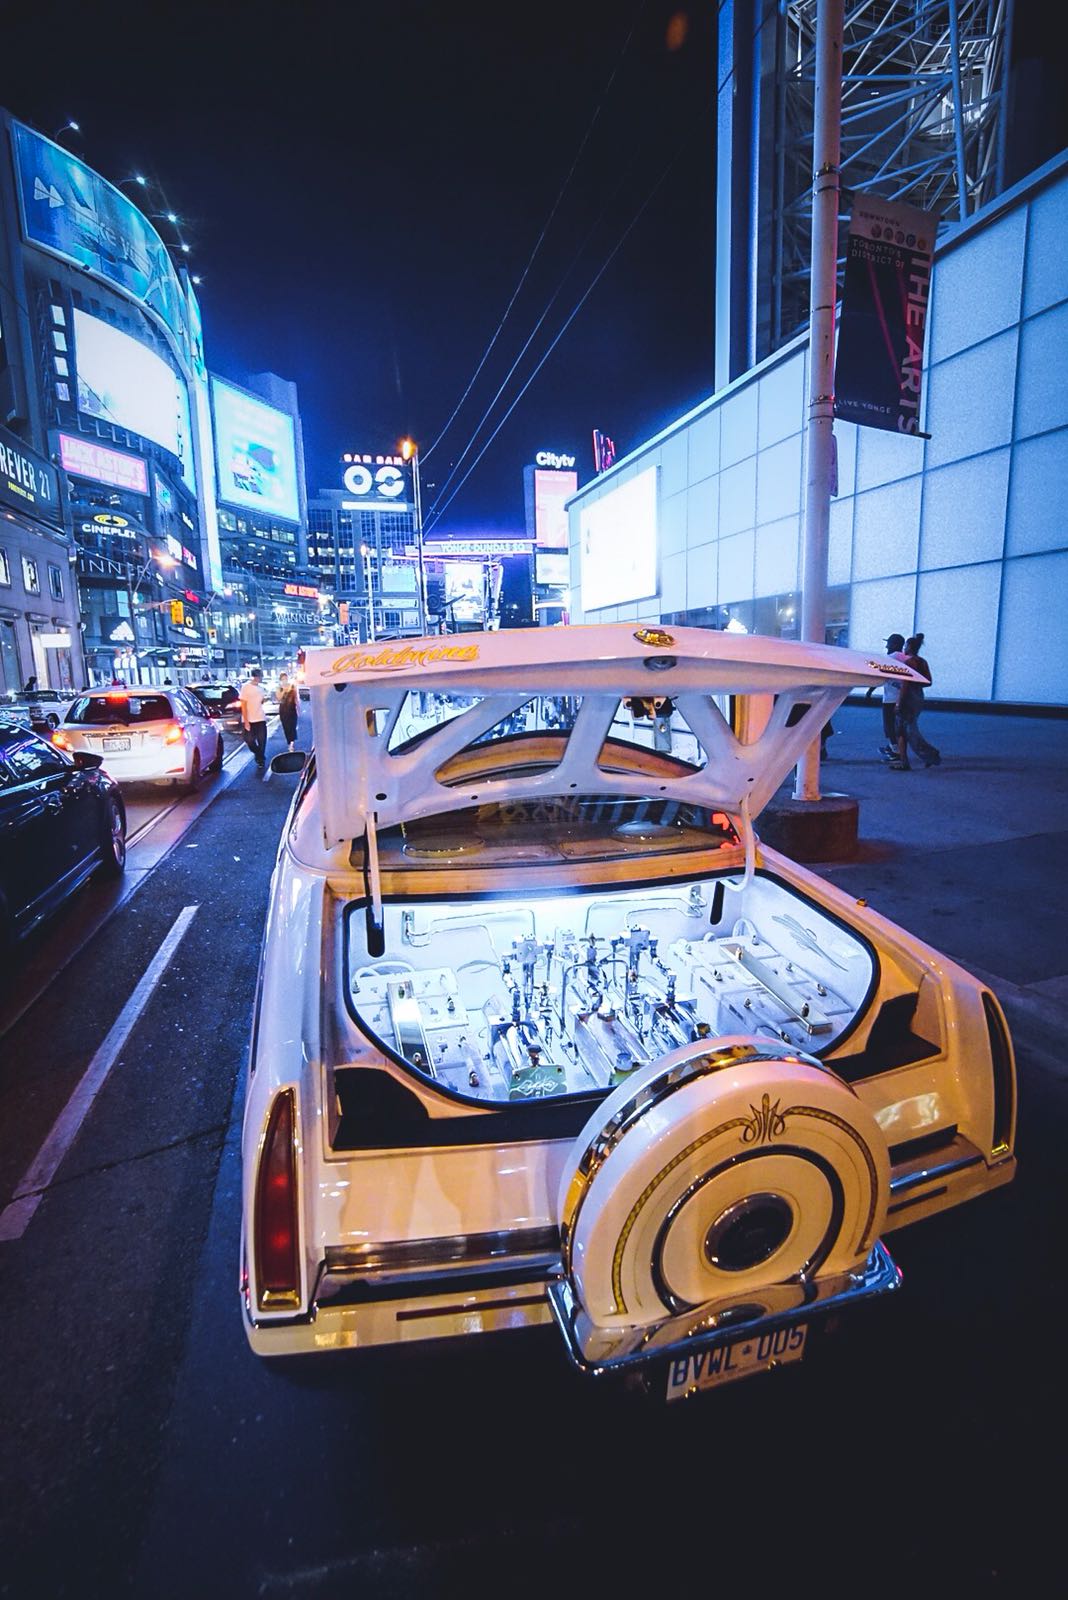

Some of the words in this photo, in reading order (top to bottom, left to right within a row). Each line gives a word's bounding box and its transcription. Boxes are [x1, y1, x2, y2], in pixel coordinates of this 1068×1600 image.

[850, 249, 893, 265] DISTRICT
[863, 402, 892, 414] YONGE
[535, 451, 576, 469] Citytv
[39, 469, 51, 501] 21
[82, 523, 137, 539] CINEPLEX
[276, 611, 327, 625] WINNERS
[672, 1346, 738, 1387] BVWL
